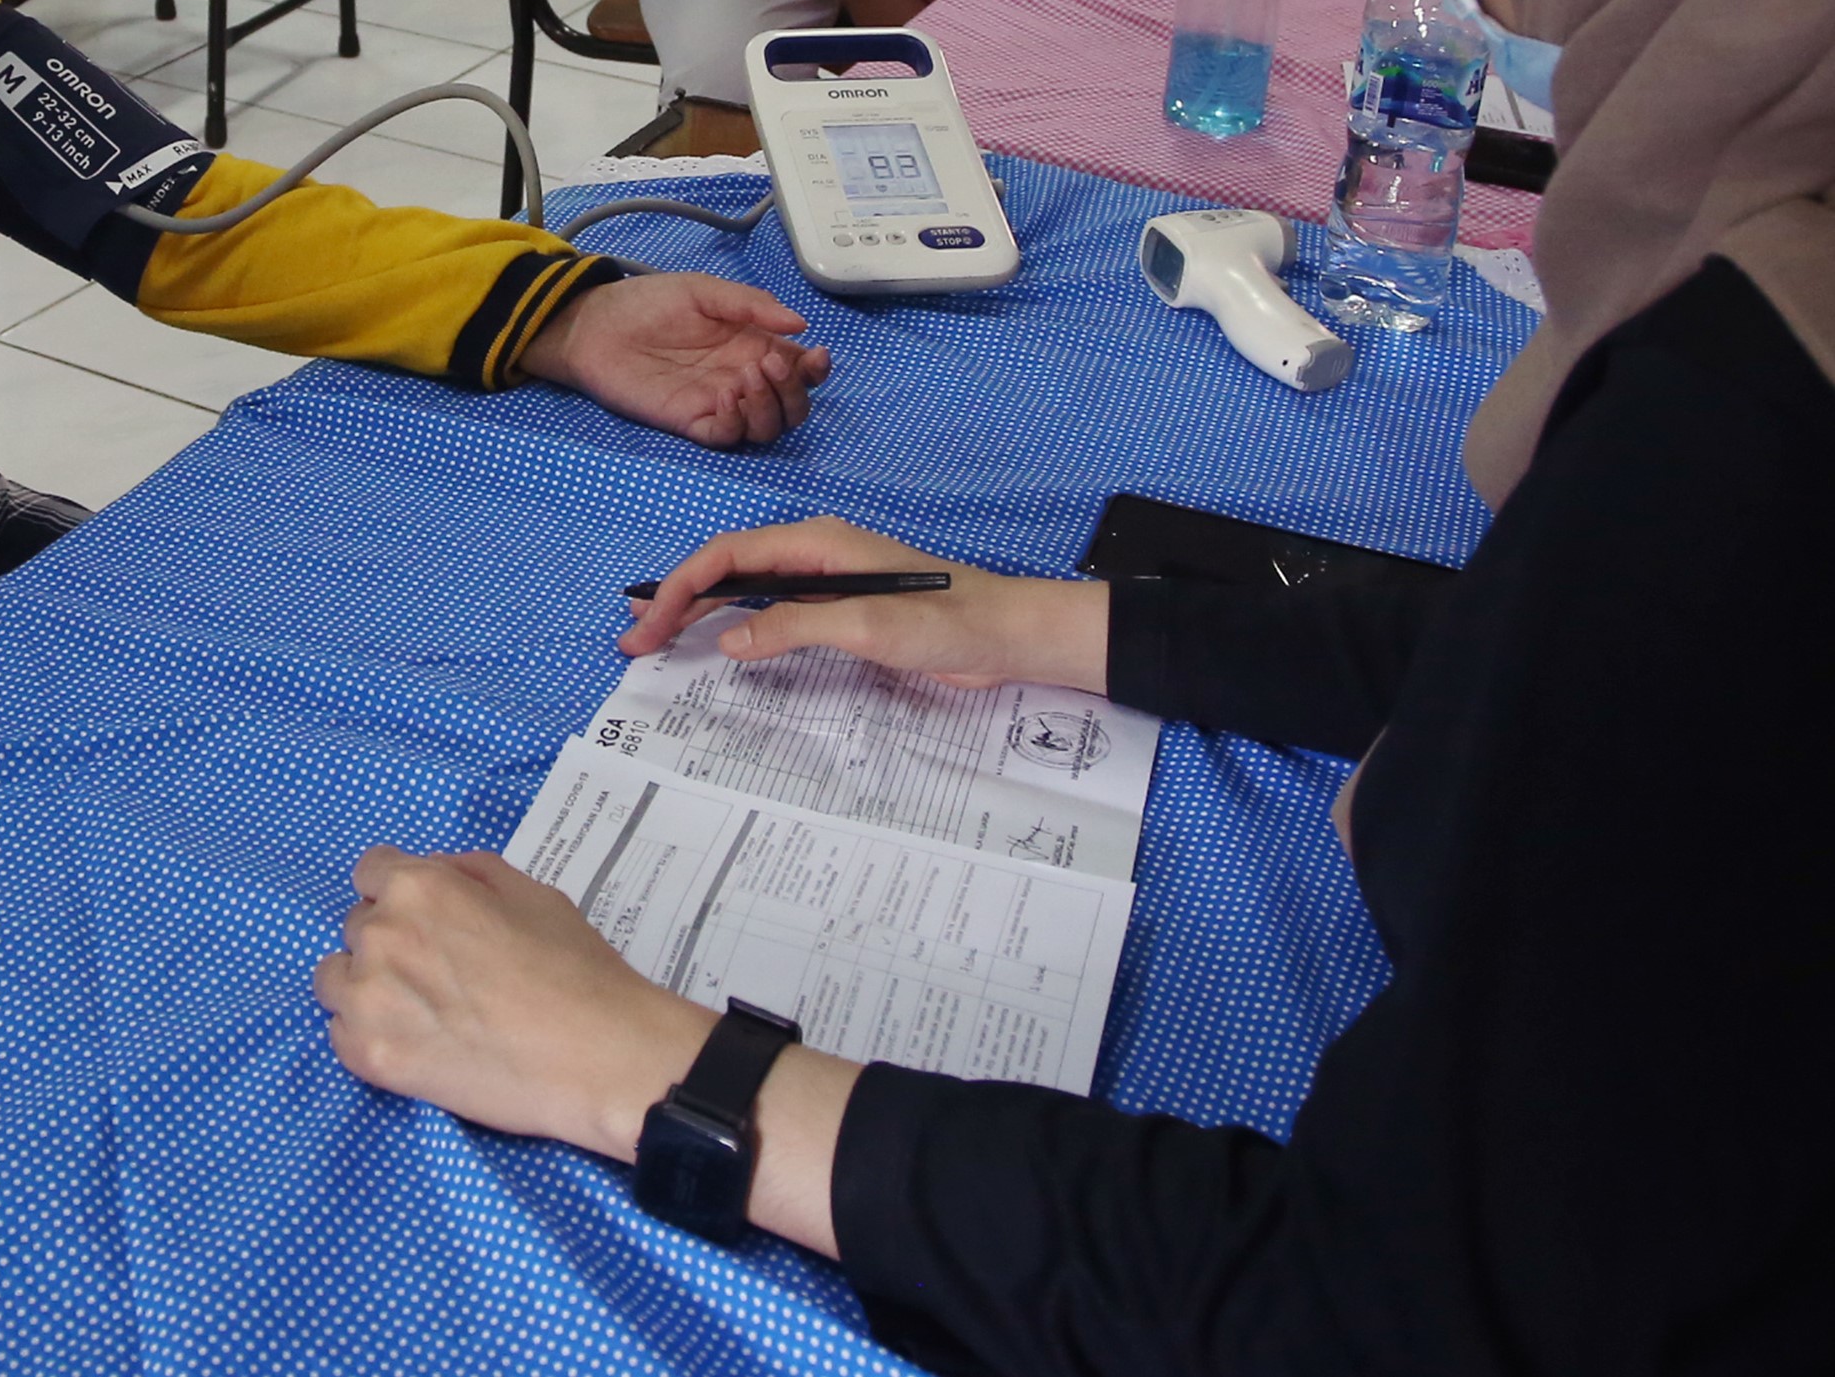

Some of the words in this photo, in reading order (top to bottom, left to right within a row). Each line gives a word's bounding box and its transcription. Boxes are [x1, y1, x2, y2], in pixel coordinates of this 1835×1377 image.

[46, 58, 116, 120] OMRON
[828, 88, 889, 100] OMRON
[37, 92, 77, 130] 22-32
[74, 127, 96, 149] cm
[32, 111, 64, 142] 9-13
[61, 139, 91, 170] inch
[126, 164, 152, 184] MAX
[930, 228, 961, 236] START
[936, 237, 962, 246] STOP
[563, 770, 589, 808] COVID-19
[592, 788, 610, 812] LAMA
